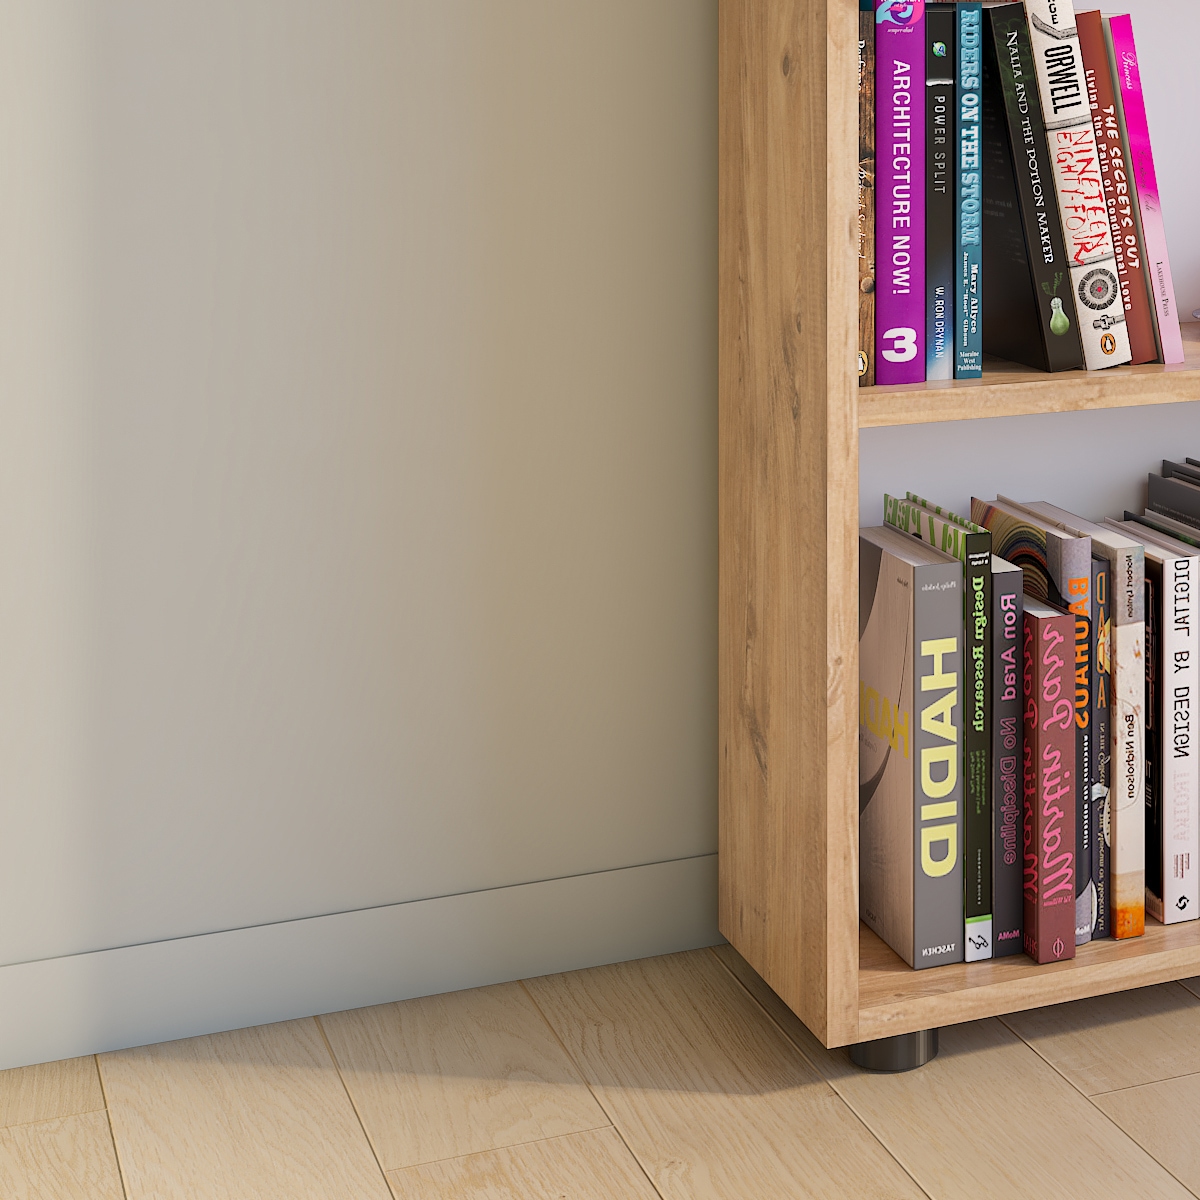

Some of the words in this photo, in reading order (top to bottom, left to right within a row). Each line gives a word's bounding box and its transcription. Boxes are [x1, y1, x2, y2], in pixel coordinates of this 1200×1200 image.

[960, 9, 980, 89] RIDERS
[1005, 30, 1022, 79] NALIA
[1044, 45, 1082, 115] ORWELL
[1085, 69, 1100, 110] Living
[1121, 51, 1137, 90] Princess
[961, 93, 979, 122] ON
[1014, 82, 1028, 114] AND
[933, 95, 946, 145] POWER
[1020, 116, 1036, 144] THE
[1093, 115, 1106, 137] the
[1102, 104, 1120, 139] THE
[892, 60, 911, 228] ARCHITECTURE
[961, 125, 979, 168] THE
[1097, 143, 1111, 172] Pain
[933, 152, 946, 195] SPLIT
[1026, 148, 1045, 207] POTION
[1104, 179, 1115, 192] of
[1109, 146, 1134, 229] SECRETS
[960, 172, 980, 246] STORM
[1036, 211, 1054, 264] MAKER
[1108, 198, 1128, 276] Conditional
[1124, 235, 1140, 269] OUT
[892, 235, 911, 294] NOW!
[970, 263, 979, 294] Mary
[935, 286, 945, 298] W.
[935, 300, 945, 319] RON
[1121, 281, 1134, 311] Love
[970, 297, 978, 334] Allyce
[881, 327, 918, 363] 3
[935, 321, 945, 358] DRYNAN
